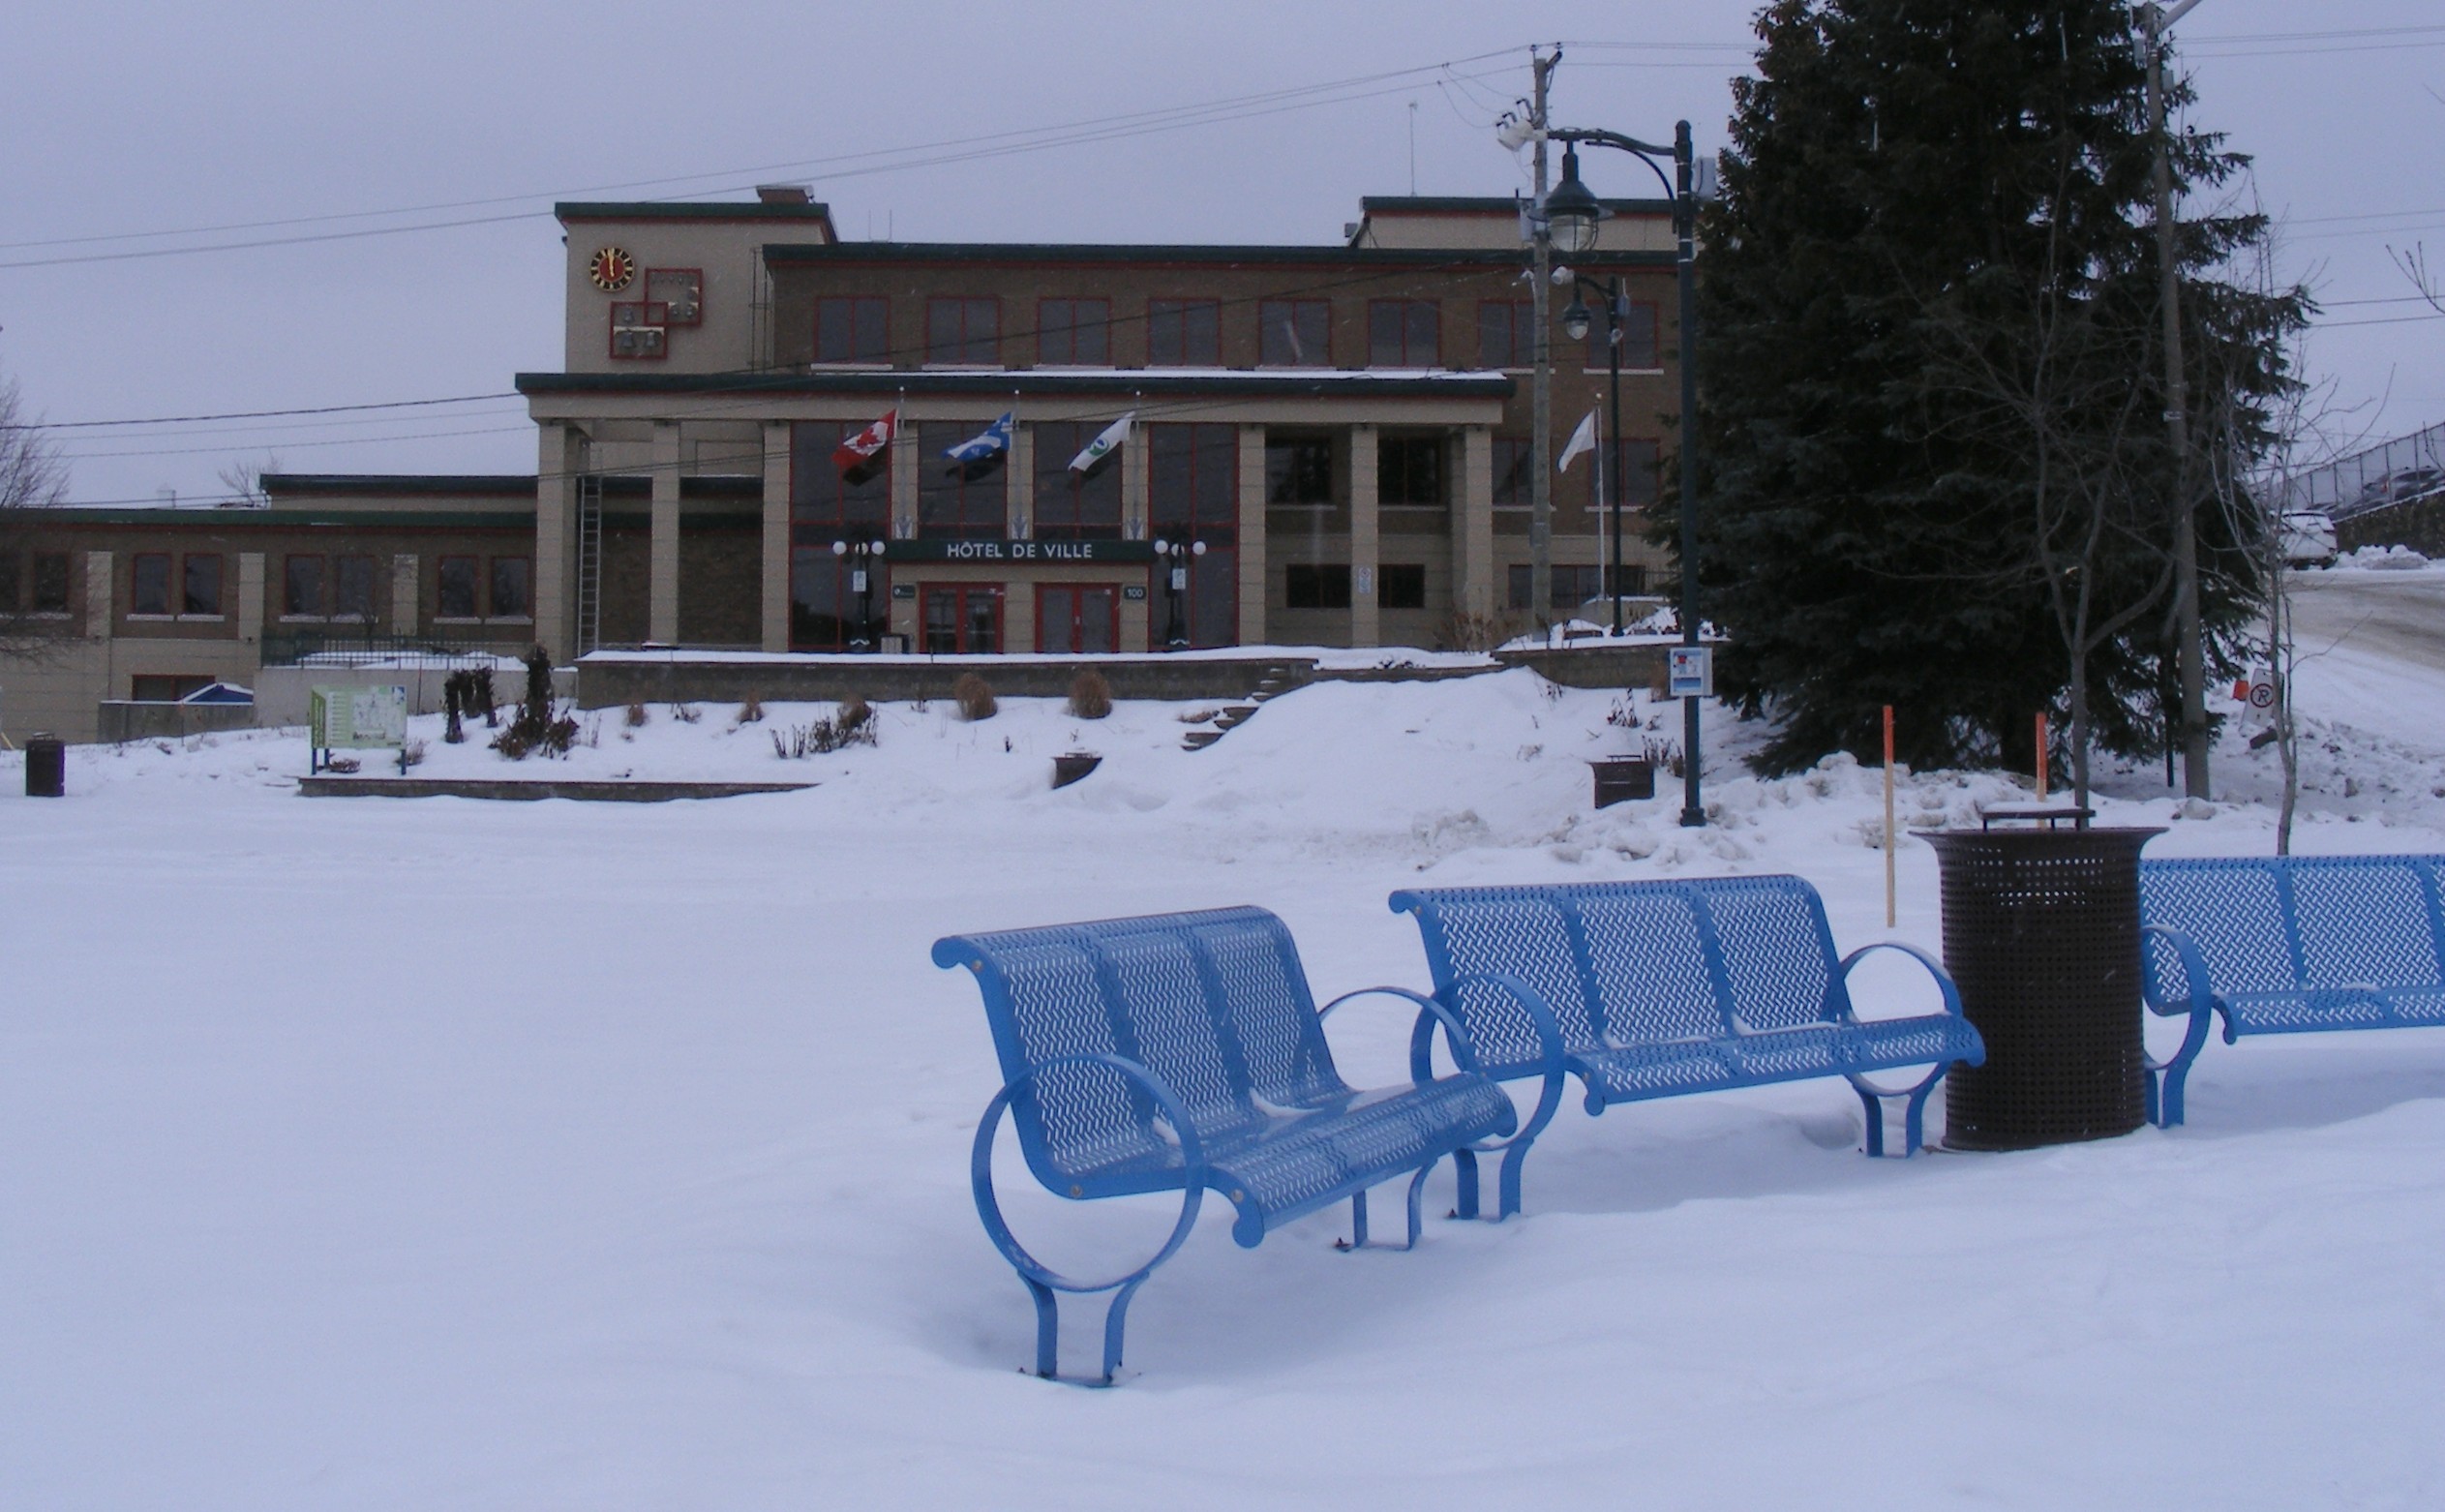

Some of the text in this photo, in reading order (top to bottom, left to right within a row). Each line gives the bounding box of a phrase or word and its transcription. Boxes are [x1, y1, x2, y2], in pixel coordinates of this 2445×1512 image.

[947, 541, 1093, 559] HÔTEL DE VILLE
[1128, 588, 1144, 598] 100
